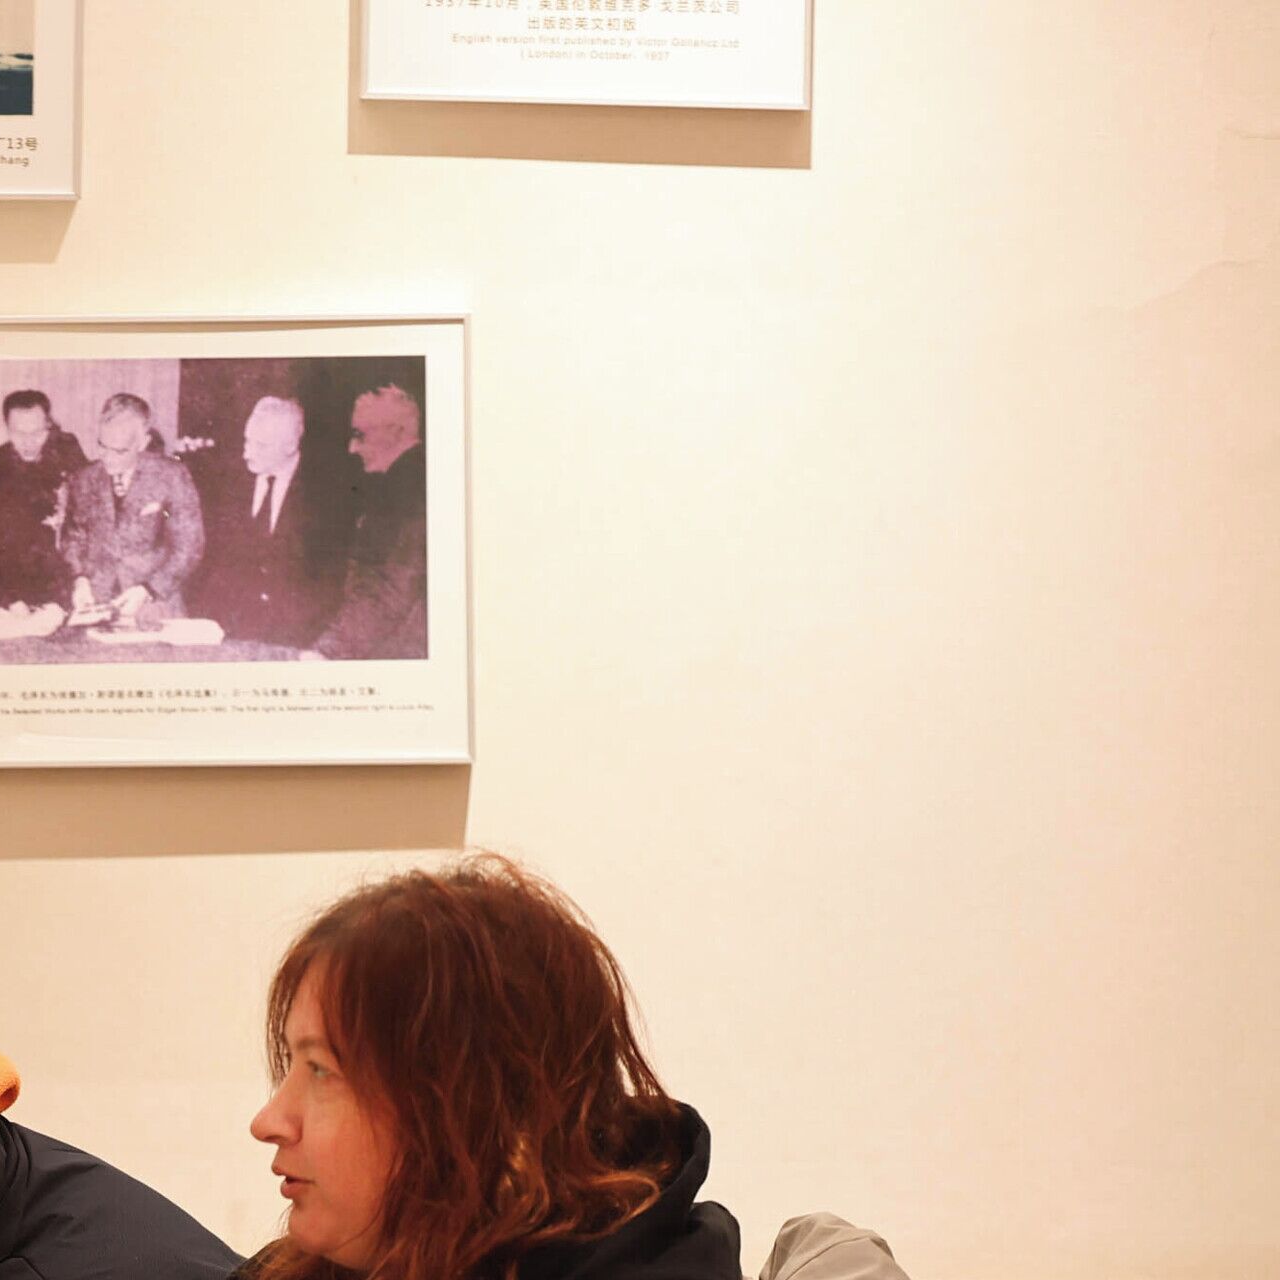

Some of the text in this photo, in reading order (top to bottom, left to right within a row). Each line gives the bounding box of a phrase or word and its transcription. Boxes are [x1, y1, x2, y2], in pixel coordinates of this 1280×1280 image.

[527, 17, 636, 31] 出版的英文初版
[452, 33, 493, 44] English
[538, 35, 561, 44] first
[563, 37, 616, 45] published
